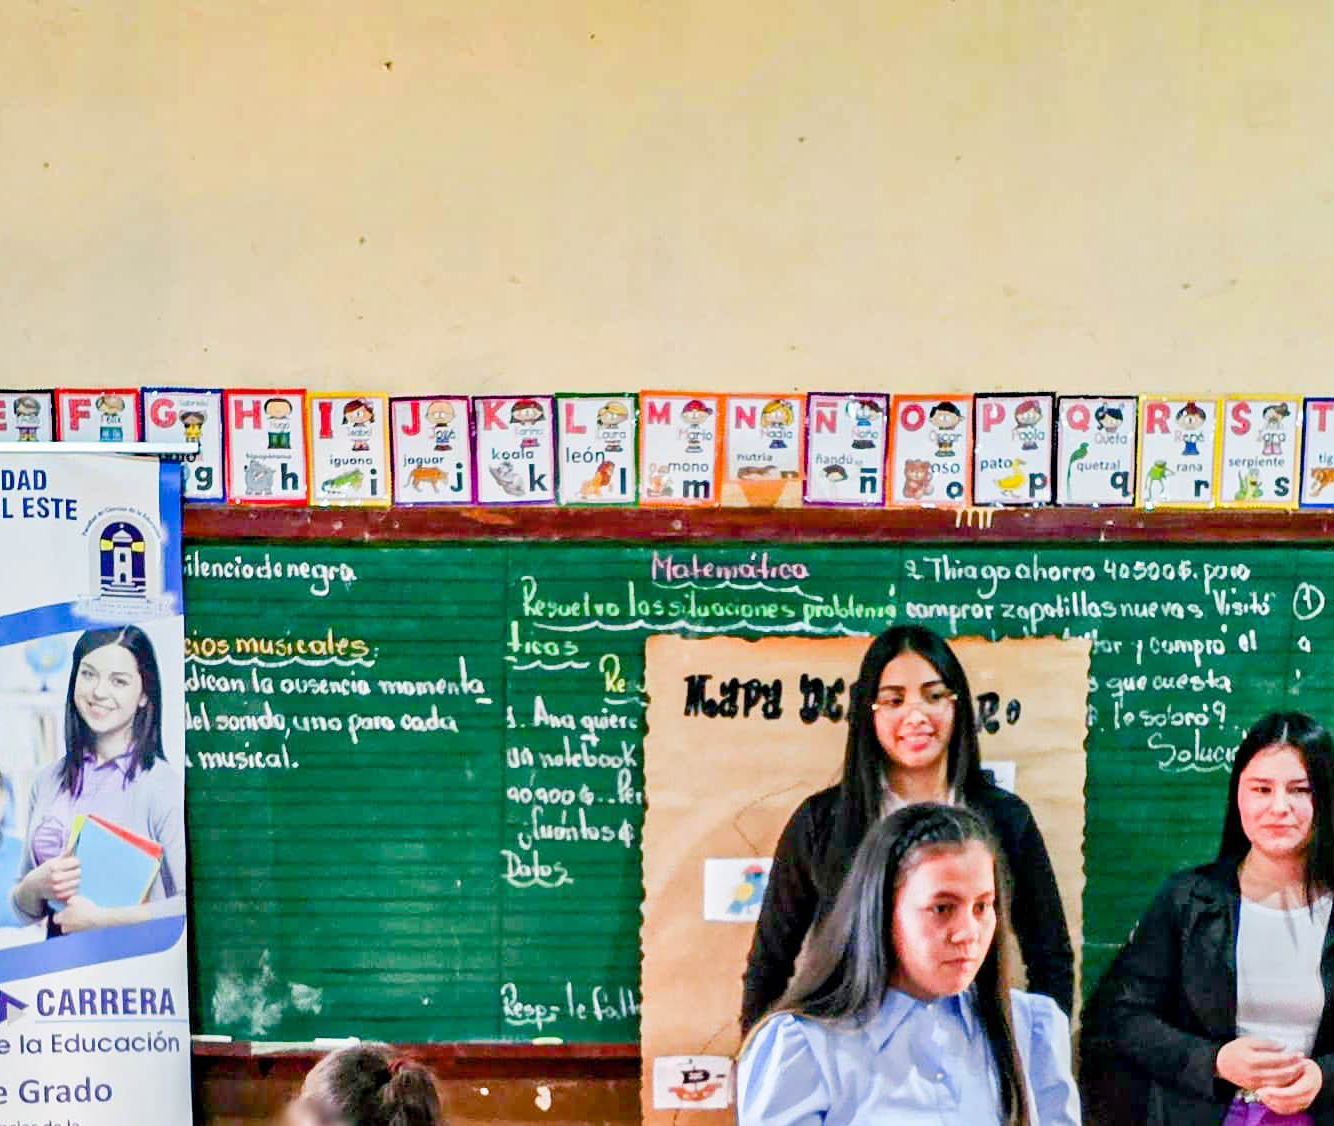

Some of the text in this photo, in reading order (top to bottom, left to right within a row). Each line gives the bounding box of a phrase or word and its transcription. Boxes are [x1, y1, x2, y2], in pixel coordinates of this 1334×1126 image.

[69, 399, 91, 430] F
[151, 399, 176, 428] G
[234, 400, 261, 429] H
[319, 402, 332, 438] I
[402, 402, 419, 436] J
[482, 400, 508, 430] K
[565, 403, 586, 434] L
[648, 402, 671, 424] M
[735, 406, 755, 428] N
[815, 402, 837, 432] Ñ
[901, 405, 924, 431] O
[983, 403, 1003, 432] P
[1067, 404, 1090, 432] Q
[1147, 403, 1171, 433] R
[1230, 402, 1251, 434] S
[1313, 404, 1334, 432] T
[330, 456, 372, 466] iguana
[403, 455, 443, 468] jaguar
[492, 448, 533, 460] koala
[566, 446, 605, 463] león
[668, 461, 709, 472] mono
[737, 452, 773, 462] nutria
[932, 462, 960, 473] oso
[980, 457, 1012, 471] pato
[1077, 460, 1120, 472] quetzal
[1177, 463, 1203, 472] rana
[1229, 456, 1284, 468] serpiente
[23, 497, 77, 521] ESTE
[652, 551, 810, 580] Matemática
[923, 557, 1010, 598] Thiago
[521, 576, 620, 618] Resuelvo
[906, 590, 1204, 634] comprar zapatillas nuevas
[251, 667, 275, 694] la
[279, 670, 372, 696] ausencia
[1107, 669, 1232, 708] que cuesta
[292, 715, 343, 732] uno
[348, 714, 396, 745] para
[400, 705, 459, 732] cada
[533, 695, 576, 729] Ana
[197, 741, 299, 769] musical.
[507, 735, 637, 769] un notebook
[501, 850, 569, 877] Datos
[37, 988, 175, 1016] CARRERA
[20, 1034, 42, 1054] la
[51, 1030, 179, 1053] Educación
[18, 1078, 113, 1105] Grado
